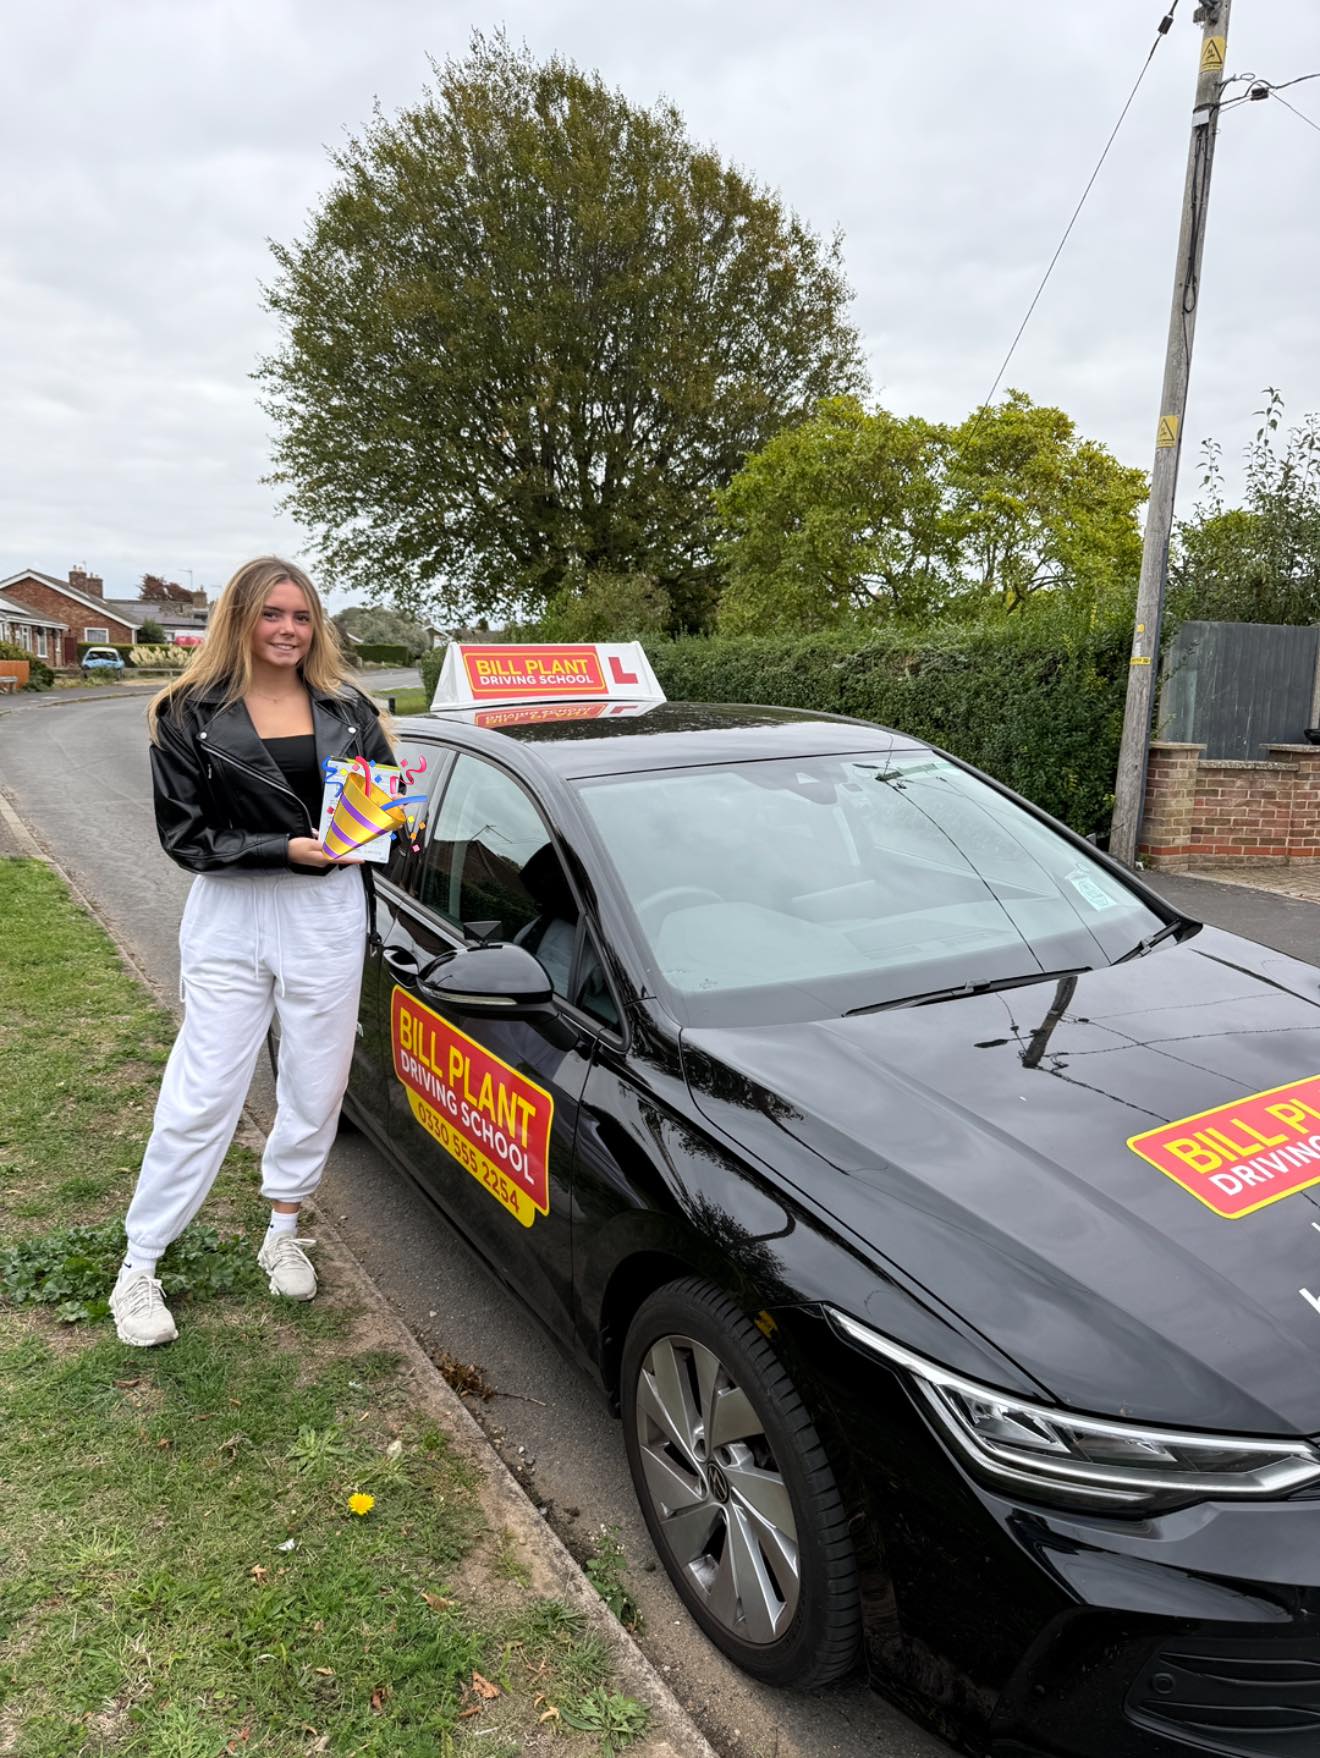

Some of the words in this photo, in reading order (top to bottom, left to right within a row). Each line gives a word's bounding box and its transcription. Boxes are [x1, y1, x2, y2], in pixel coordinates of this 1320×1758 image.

[475, 659, 522, 675] BILL
[525, 659, 588, 675] PLANT
[480, 675, 537, 685] DRIVING
[539, 674, 594, 684] SCHOOL
[608, 656, 639, 684] L
[400, 1007, 443, 1078] BILL
[450, 1046, 536, 1149] PLANT
[401, 1050, 458, 1116] DRIVING
[461, 1101, 535, 1185] SCHOOL
[418, 1102, 450, 1146] 0330
[453, 1133, 478, 1173] 555
[482, 1160, 520, 1214] 2254
[1163, 1118, 1289, 1175] BILL
